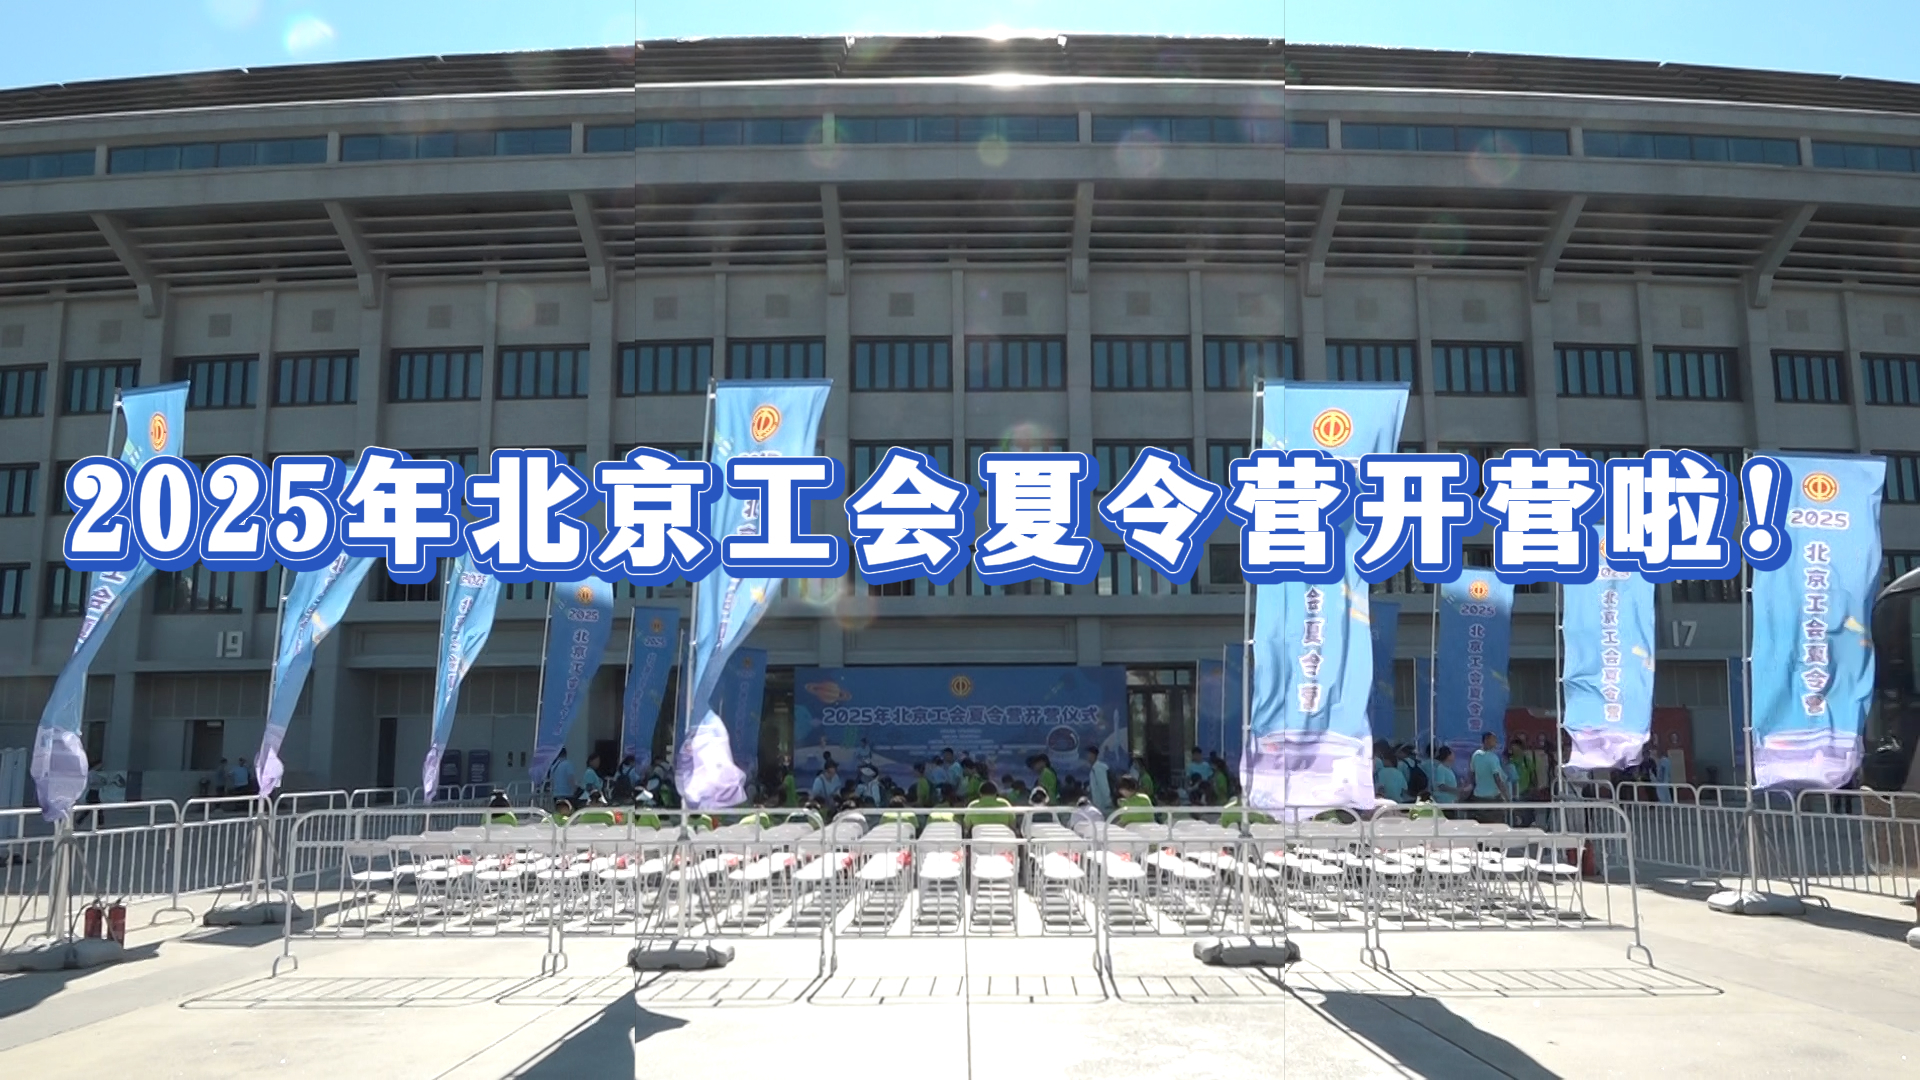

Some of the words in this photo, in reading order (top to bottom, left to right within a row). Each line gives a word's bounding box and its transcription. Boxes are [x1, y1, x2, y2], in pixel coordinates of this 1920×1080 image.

[1789, 509, 1849, 530] 2025
[567, 607, 599, 622] 2025
[1459, 603, 1496, 618] 2025
[215, 631, 243, 658] 19
[1672, 620, 1698, 648] 17
[822, 705, 1100, 726] 2025年北京工会夏令营开营仪式
